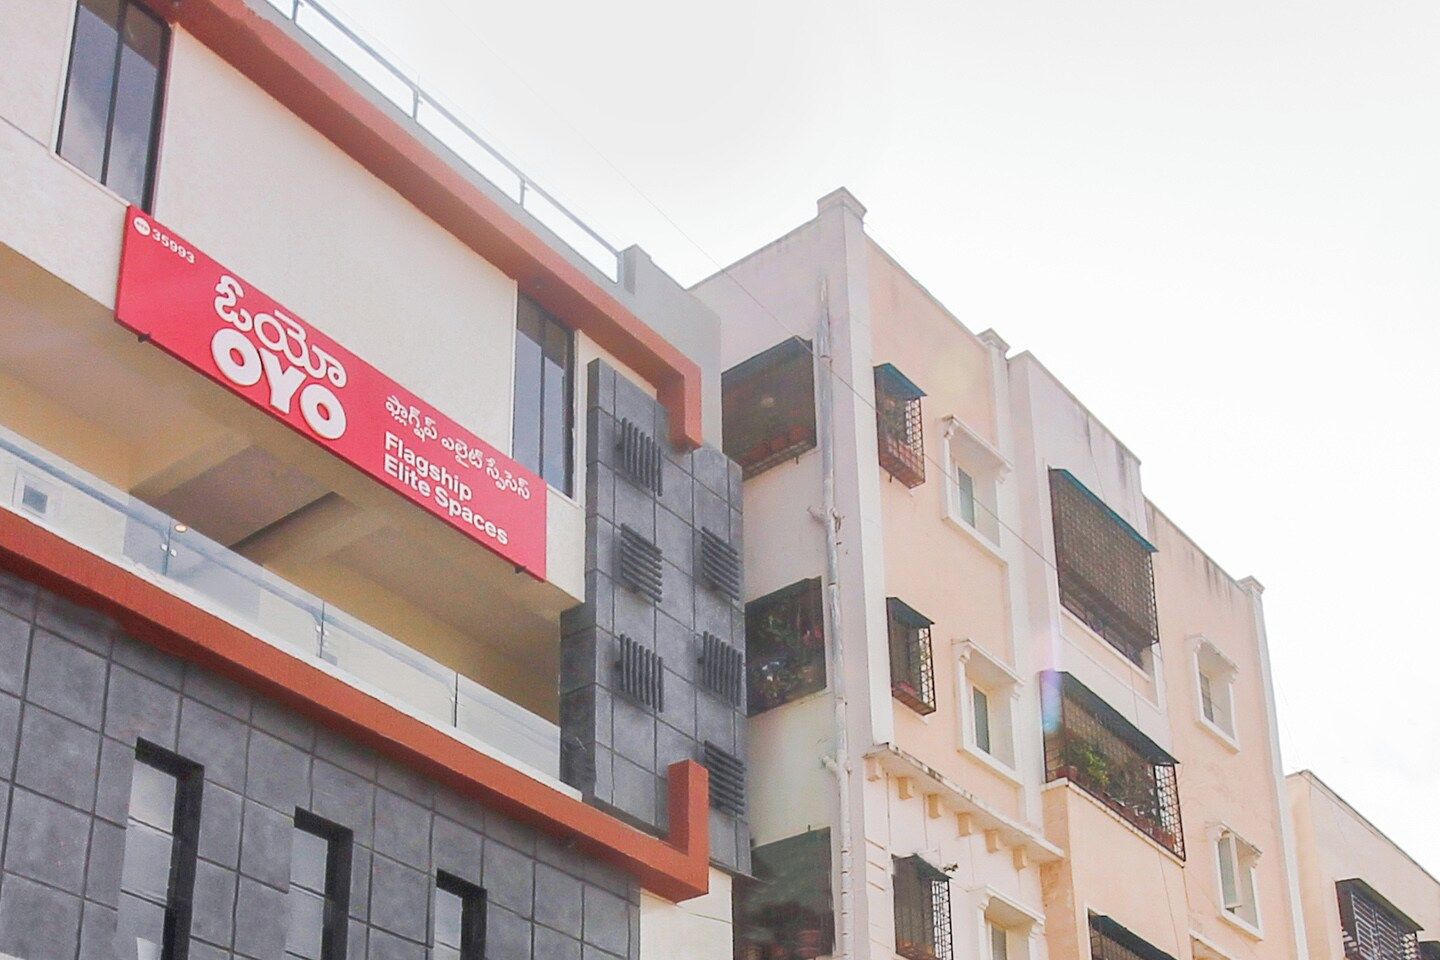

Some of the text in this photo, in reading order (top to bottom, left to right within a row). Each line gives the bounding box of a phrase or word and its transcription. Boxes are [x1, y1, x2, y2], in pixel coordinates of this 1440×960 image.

[152, 229, 195, 264] 35993
[214, 275, 348, 388] ఓయో
[211, 328, 347, 440] OYO
[384, 453, 508, 544] Elite Spaces
[385, 431, 473, 501] Flagship
